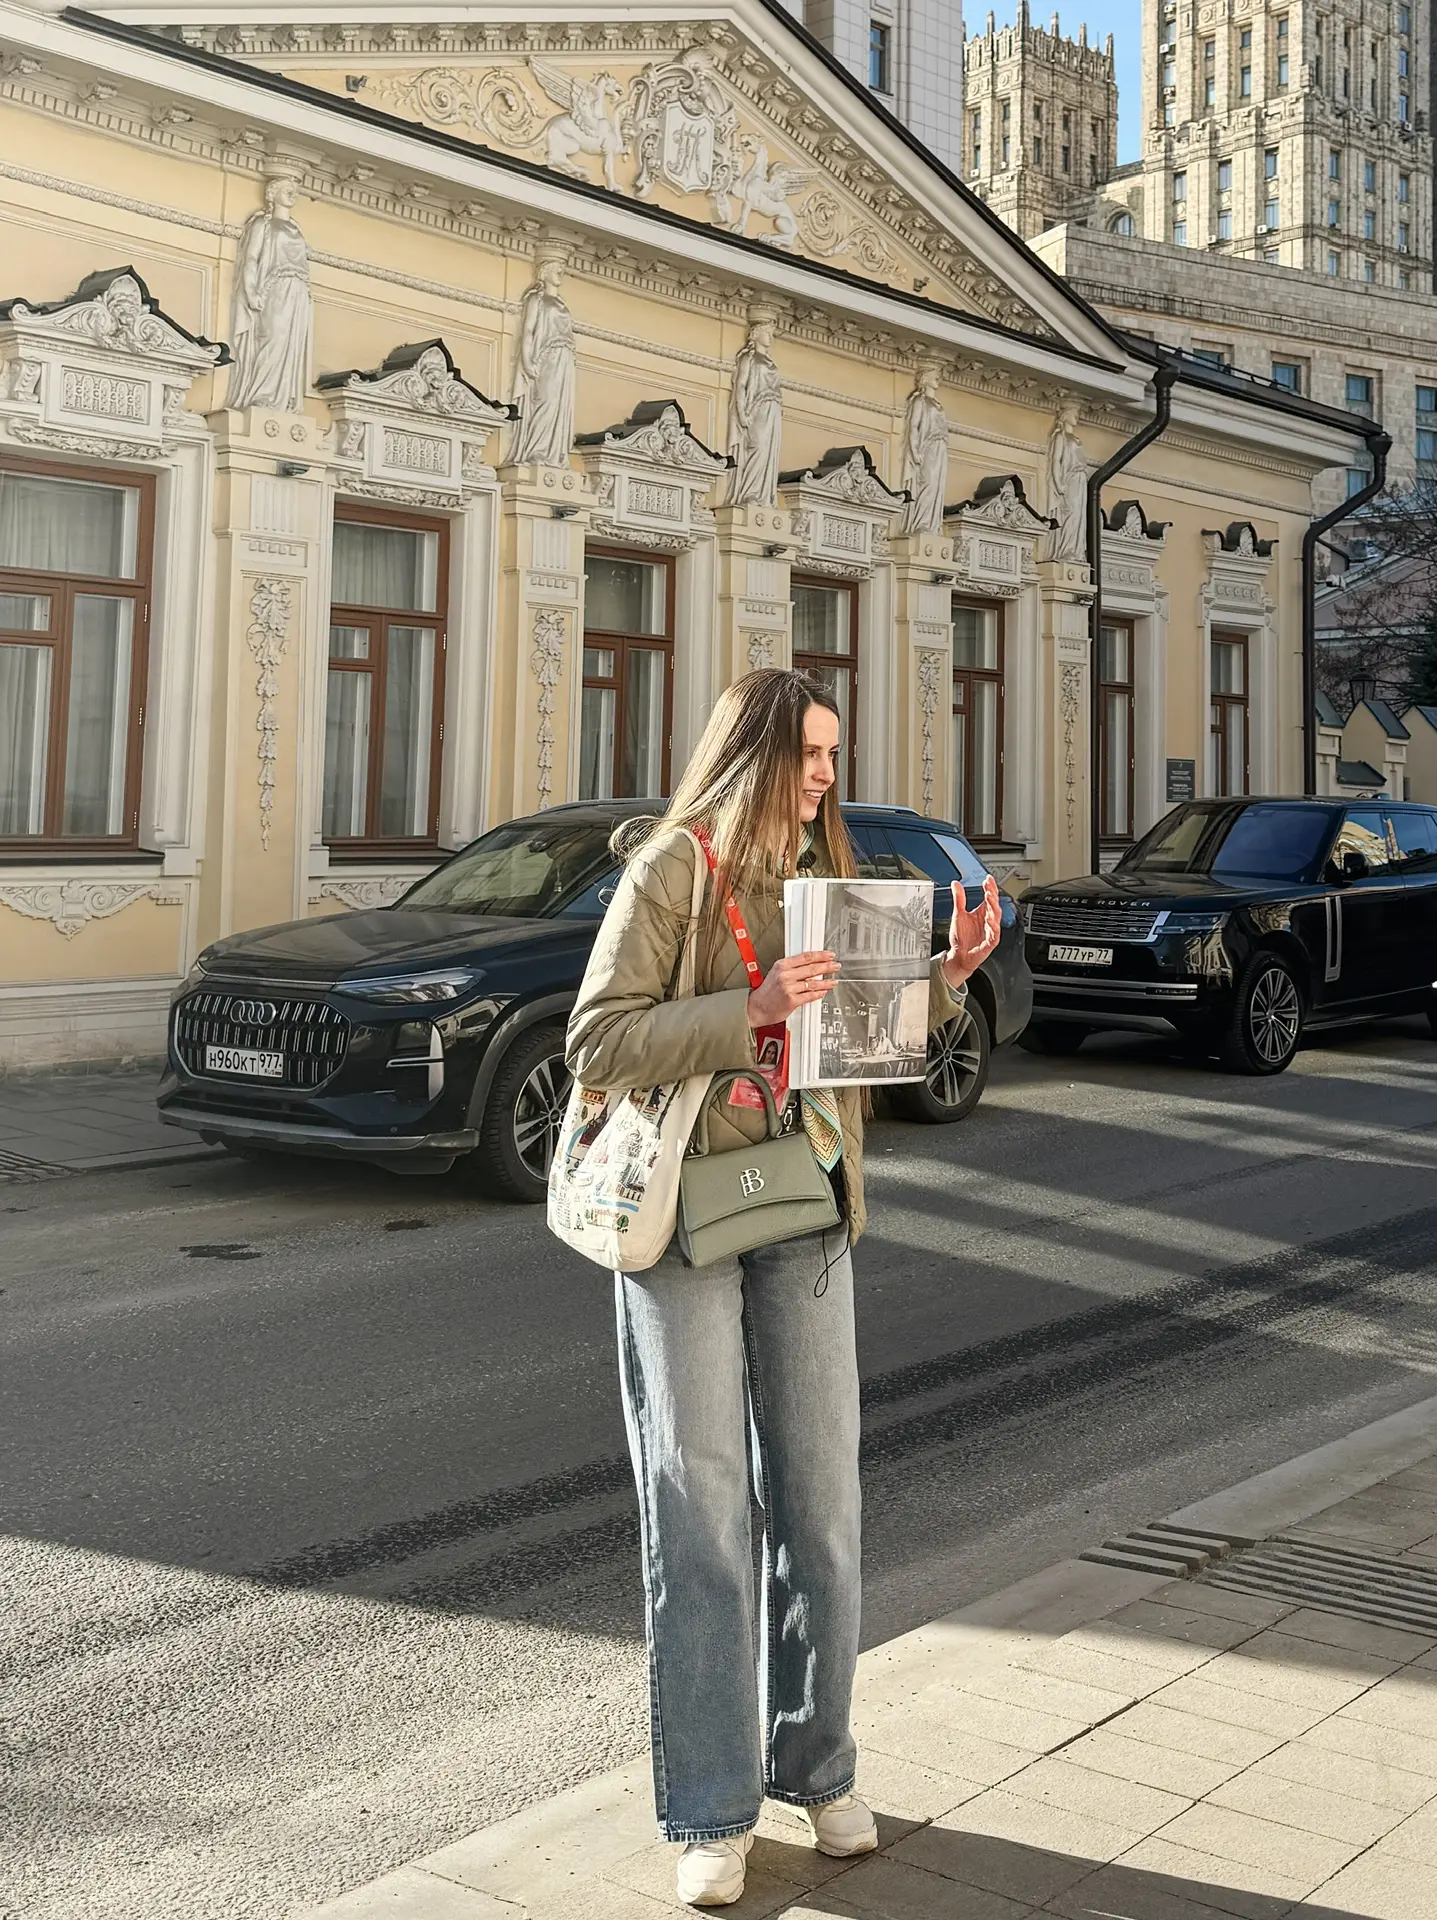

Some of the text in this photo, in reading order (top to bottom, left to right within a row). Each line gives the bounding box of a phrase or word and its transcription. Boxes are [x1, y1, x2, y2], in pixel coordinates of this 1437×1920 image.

[1045, 896, 1089, 904] RANGE
[209, 1049, 280, 1073] Н960КТ 977
